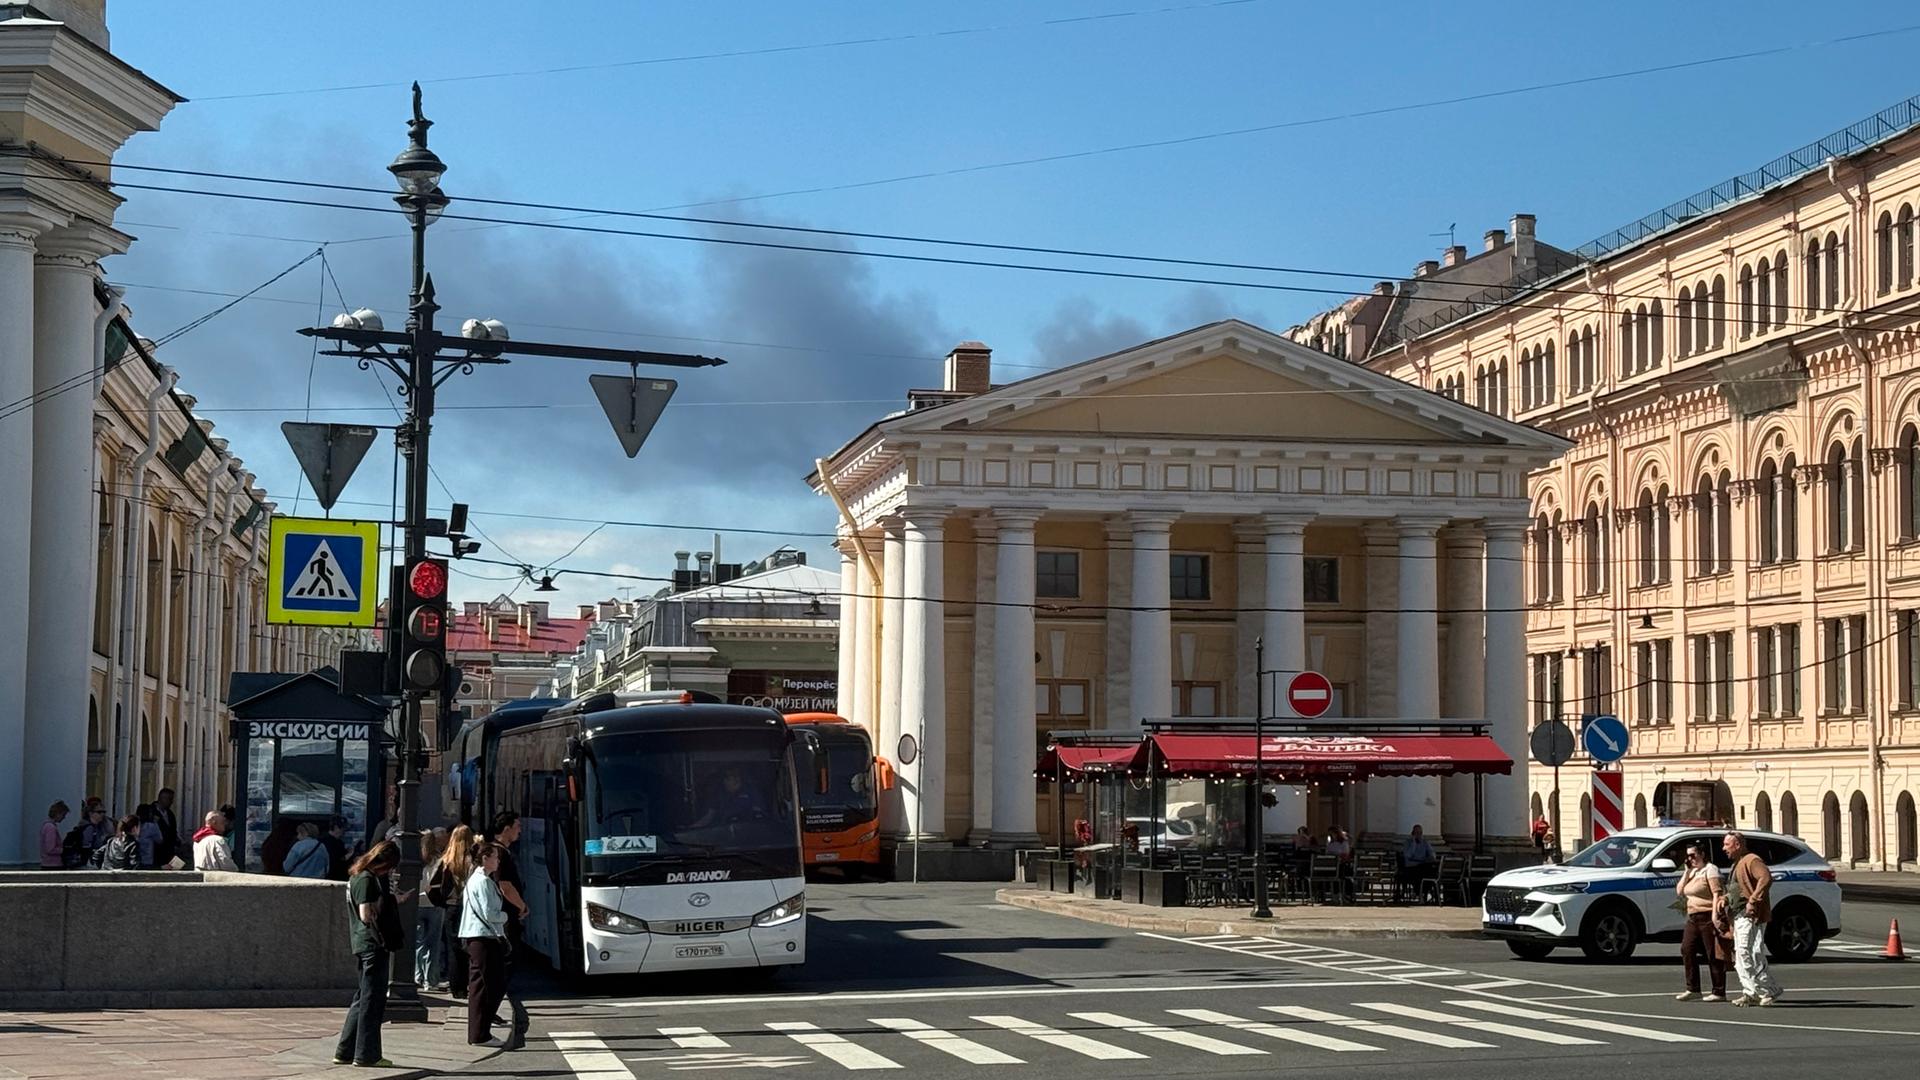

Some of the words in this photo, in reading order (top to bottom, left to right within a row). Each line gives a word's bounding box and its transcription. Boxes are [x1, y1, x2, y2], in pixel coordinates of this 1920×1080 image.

[774, 697, 809, 710] МУЗЕЙ
[249, 722, 369, 739] ЭКСКУРСИИ
[1283, 743, 1398, 752] БАЛТИКА
[675, 921, 725, 932] HIGER
